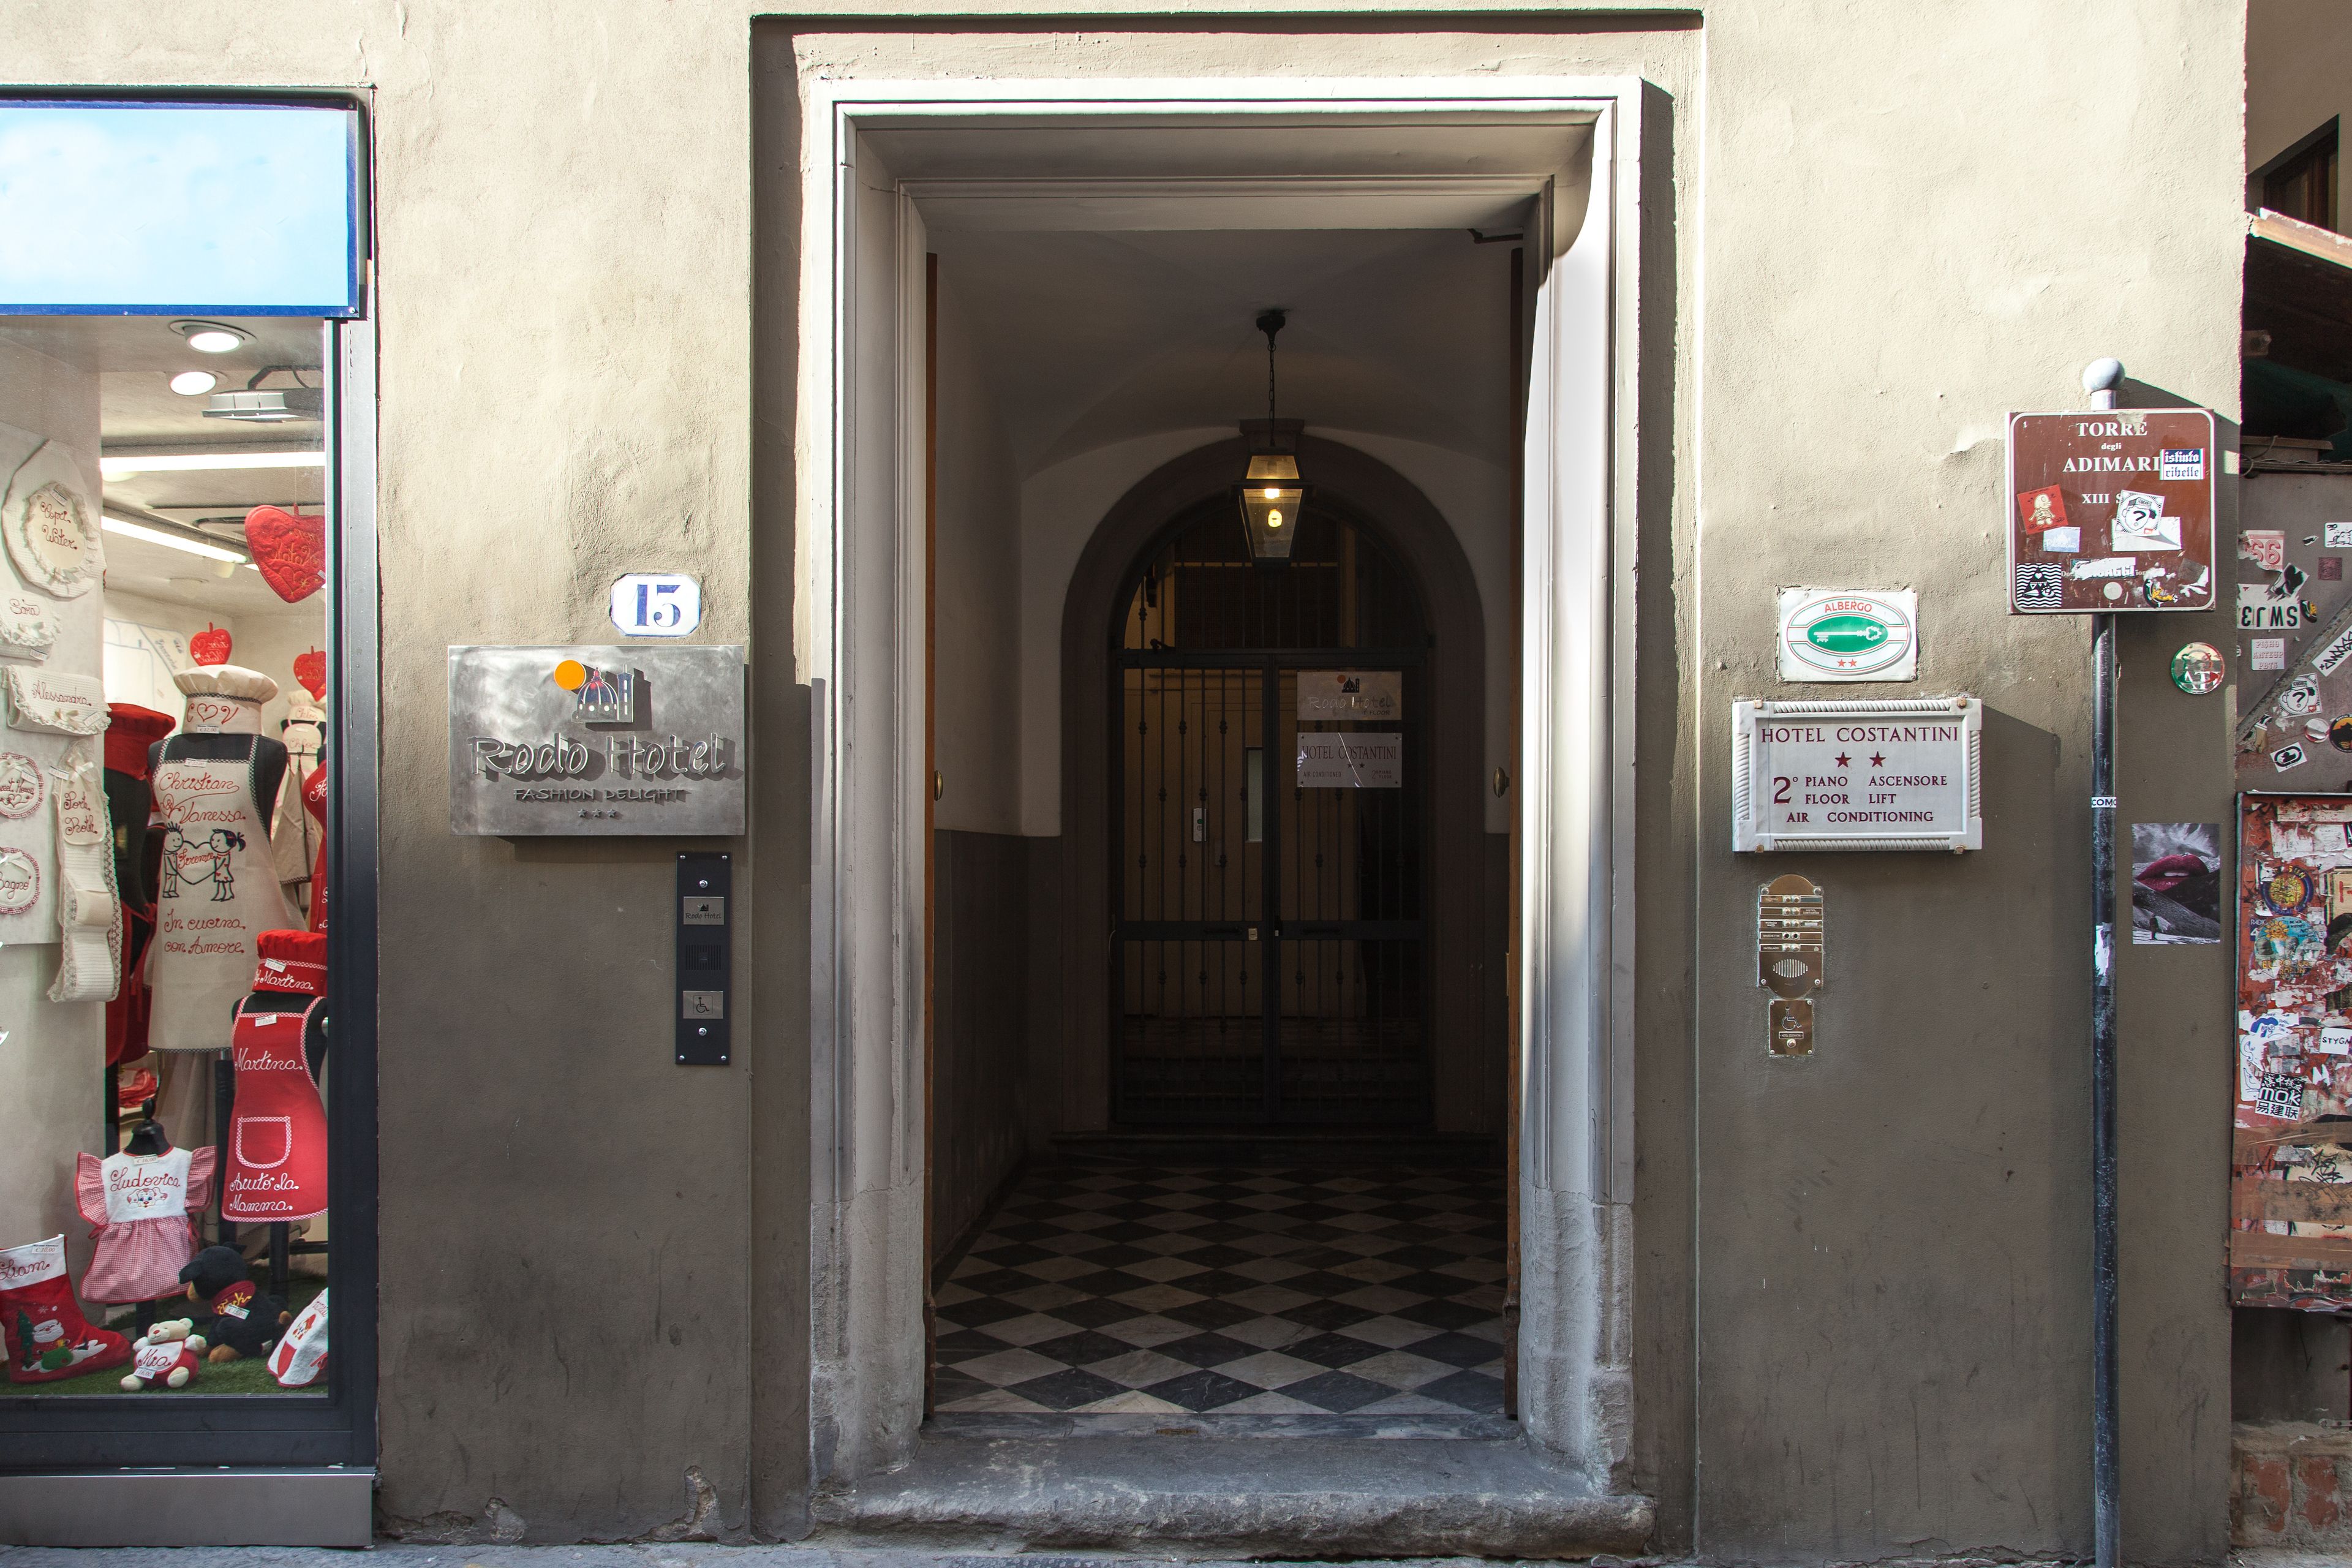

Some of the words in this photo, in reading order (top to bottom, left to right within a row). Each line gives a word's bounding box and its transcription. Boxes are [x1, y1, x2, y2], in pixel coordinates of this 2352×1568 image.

[2077, 421, 2148, 437] TORRE
[2101, 442, 2123, 452] degli
[2081, 493, 2109, 505] XIII
[10, 598, 40, 616] Sara
[1824, 600, 1872, 612] ALBERGO
[32, 680, 92, 706] Alessandra
[1351, 695, 1392, 708] Hotel
[1762, 727, 1825, 743] HOTEL
[1836, 726, 1959, 742] COSTANTINI
[467, 732, 589, 775] Rodo
[603, 732, 727, 775] Hotel
[1302, 745, 1334, 760] HOTEL
[1338, 745, 1397, 760] COSTANTINI
[159, 771, 240, 791] Christian
[1804, 776, 1848, 787] PIANO
[1868, 775, 1948, 786] ASCENSORE
[513, 788, 595, 802] FASHION
[603, 788, 685, 802] DELIGHT
[1804, 794, 1850, 805] FLOOR
[1868, 794, 1897, 805] LIFT
[173, 802, 246, 824] Vanessa
[1786, 812, 1810, 823] AIR
[1827, 811, 1934, 823] CONDITIONING
[164, 908, 183, 933] In
[187, 918, 246, 930] cucina
[164, 941, 186, 953] con
[187, 936, 245, 955] Amore
[259, 970, 314, 990] Martina
[235, 1047, 304, 1071] Martina
[110, 1166, 181, 1192] Ludovica
[229, 1193, 293, 1212] Mamma
[138, 1348, 172, 1367] Mia
